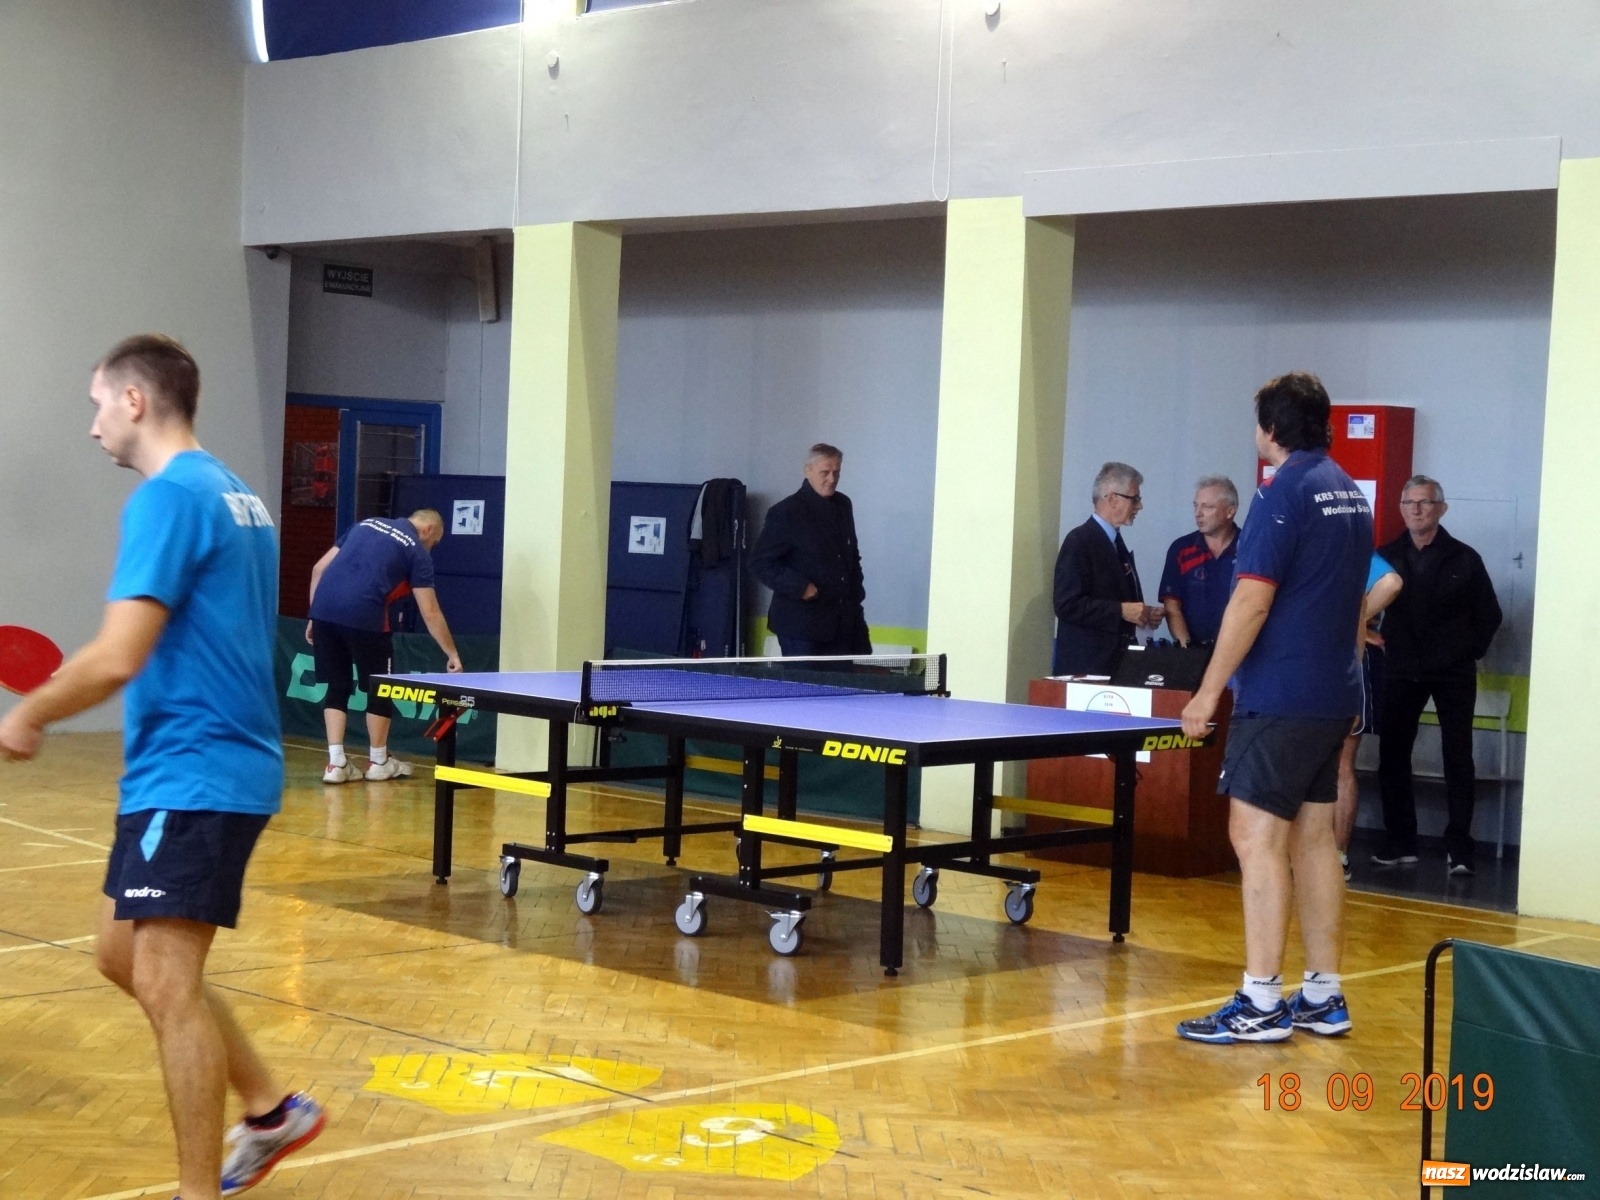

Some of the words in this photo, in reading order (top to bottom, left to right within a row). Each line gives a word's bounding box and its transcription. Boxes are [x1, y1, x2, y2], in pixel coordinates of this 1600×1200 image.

[1314, 491, 1334, 503] KRS
[377, 684, 436, 704] DONIC
[822, 740, 907, 765] DONIC
[124, 886, 162, 898] andro
